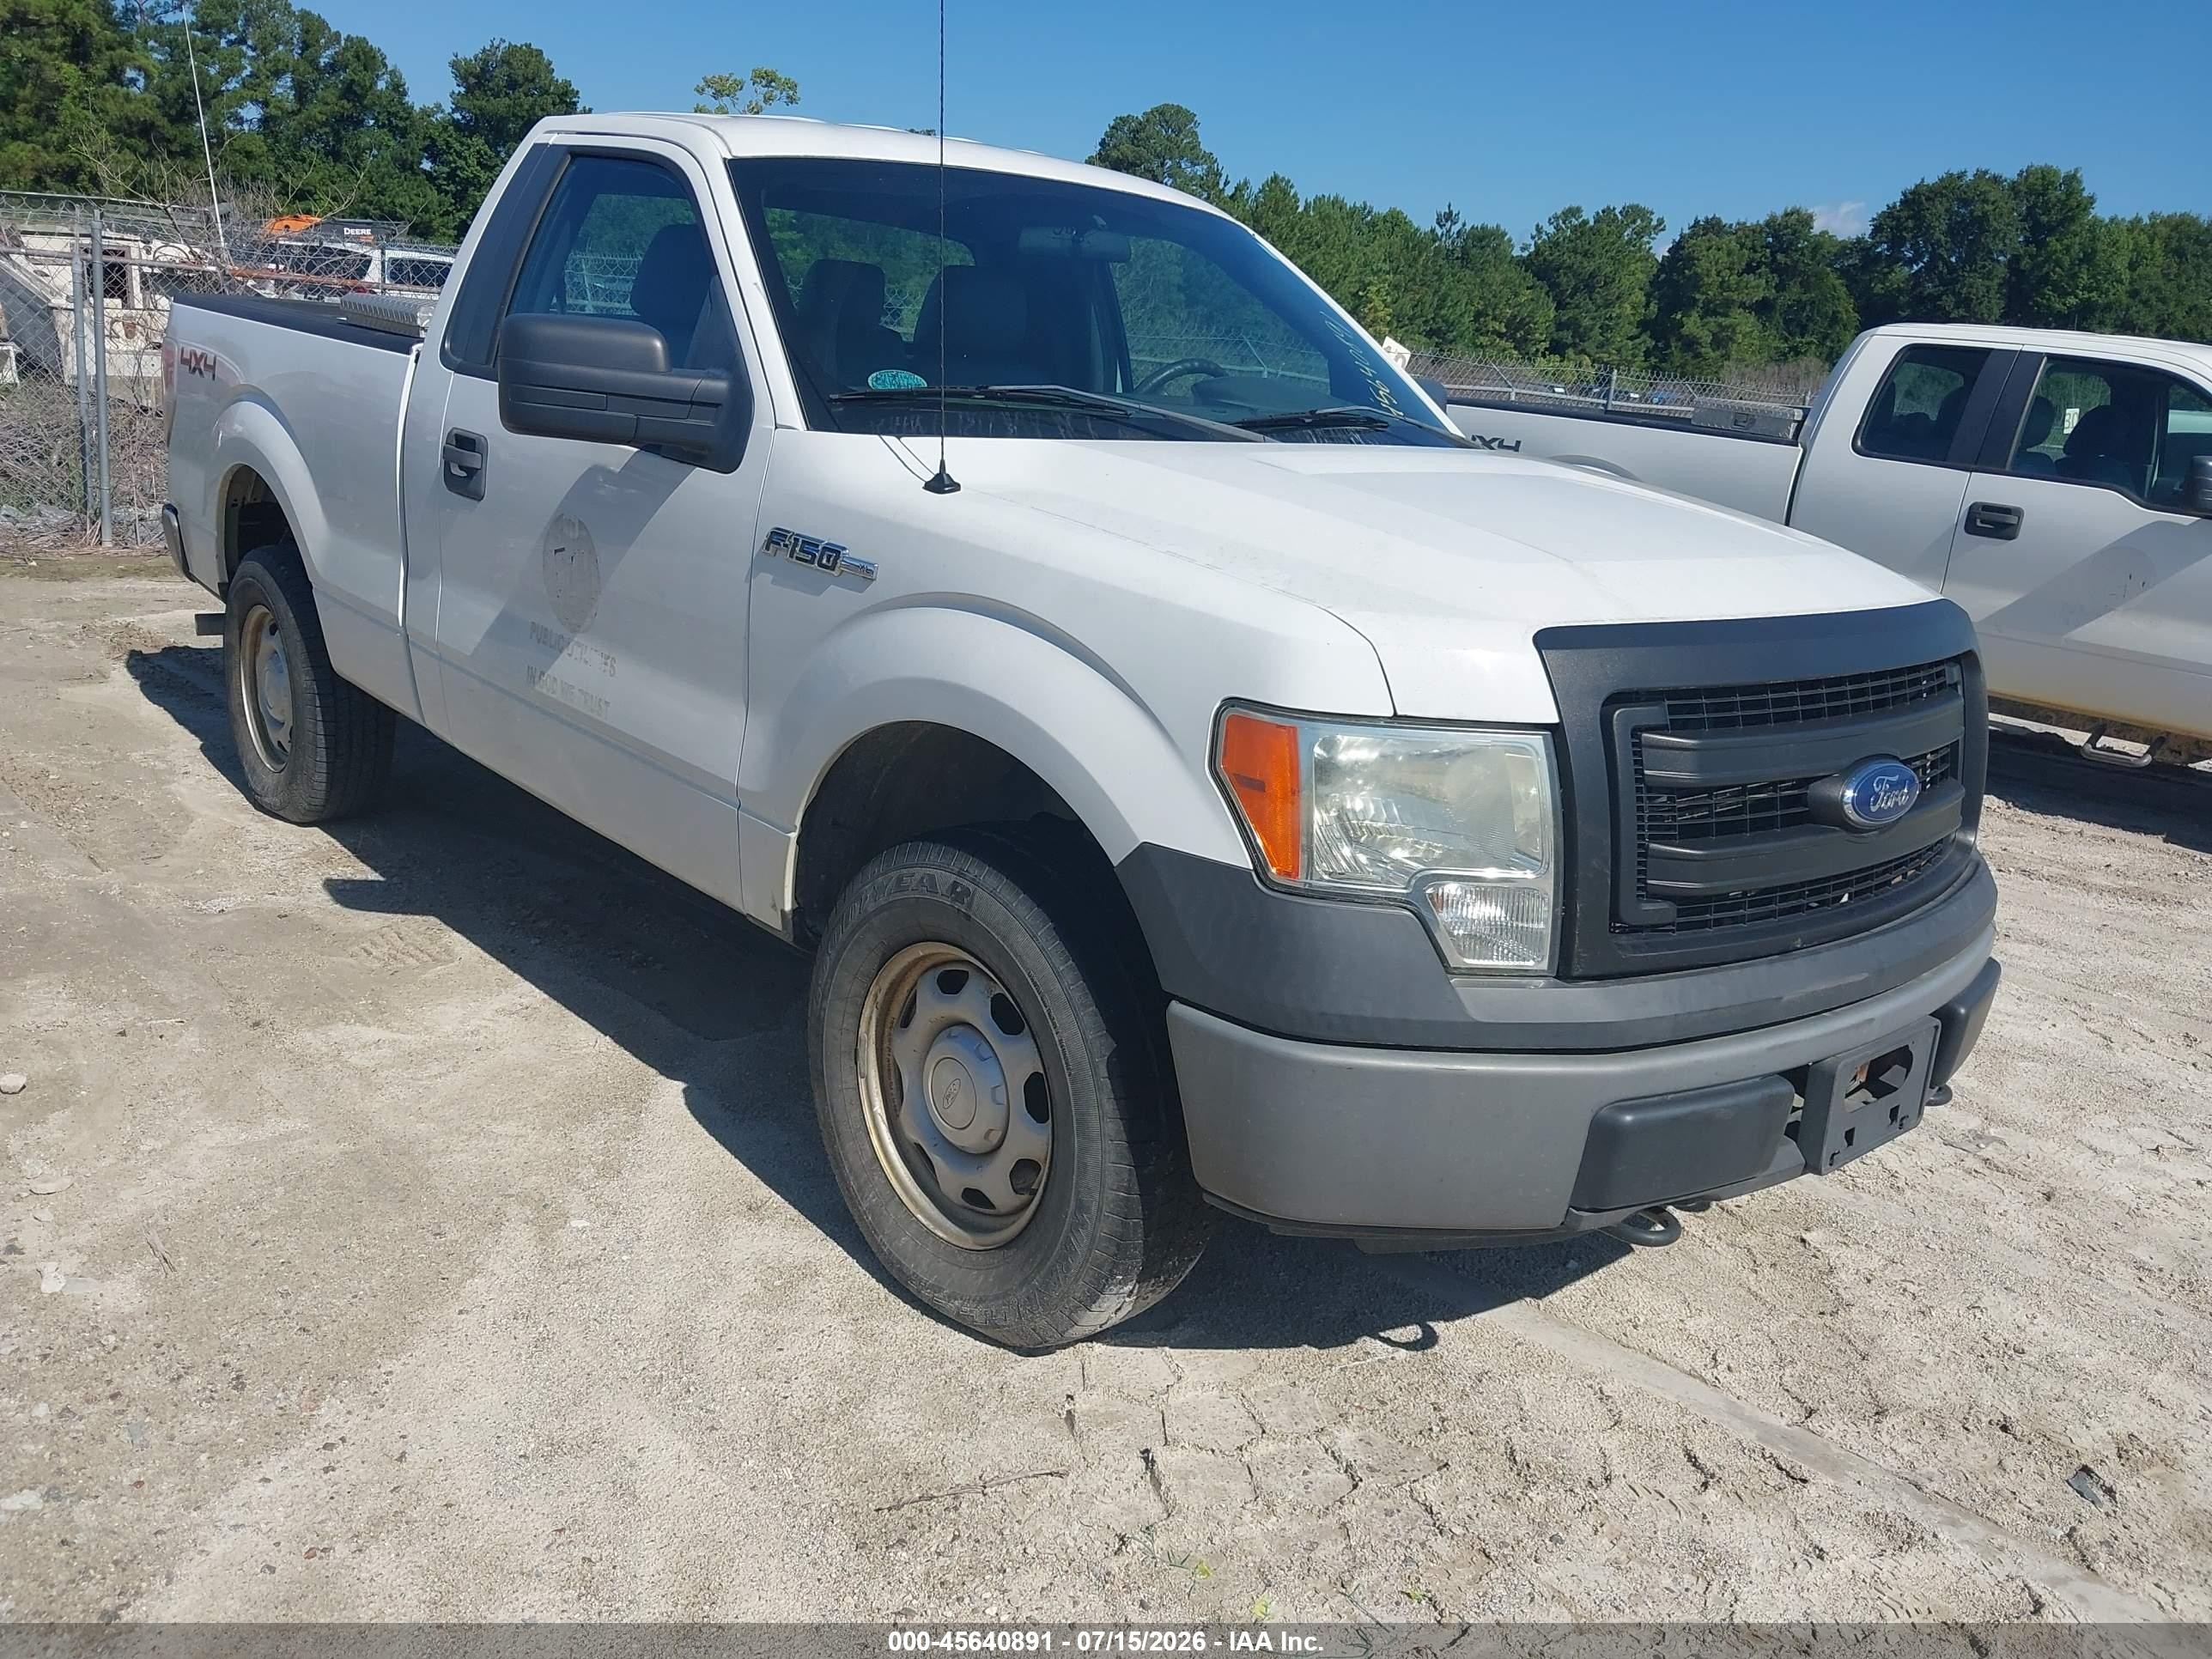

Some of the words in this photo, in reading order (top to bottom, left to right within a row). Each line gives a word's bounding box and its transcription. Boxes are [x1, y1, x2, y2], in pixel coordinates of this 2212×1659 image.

[180, 346, 217, 381] 4X4
[1471, 434, 1522, 453] X4
[1870, 775, 1910, 812] Ford
